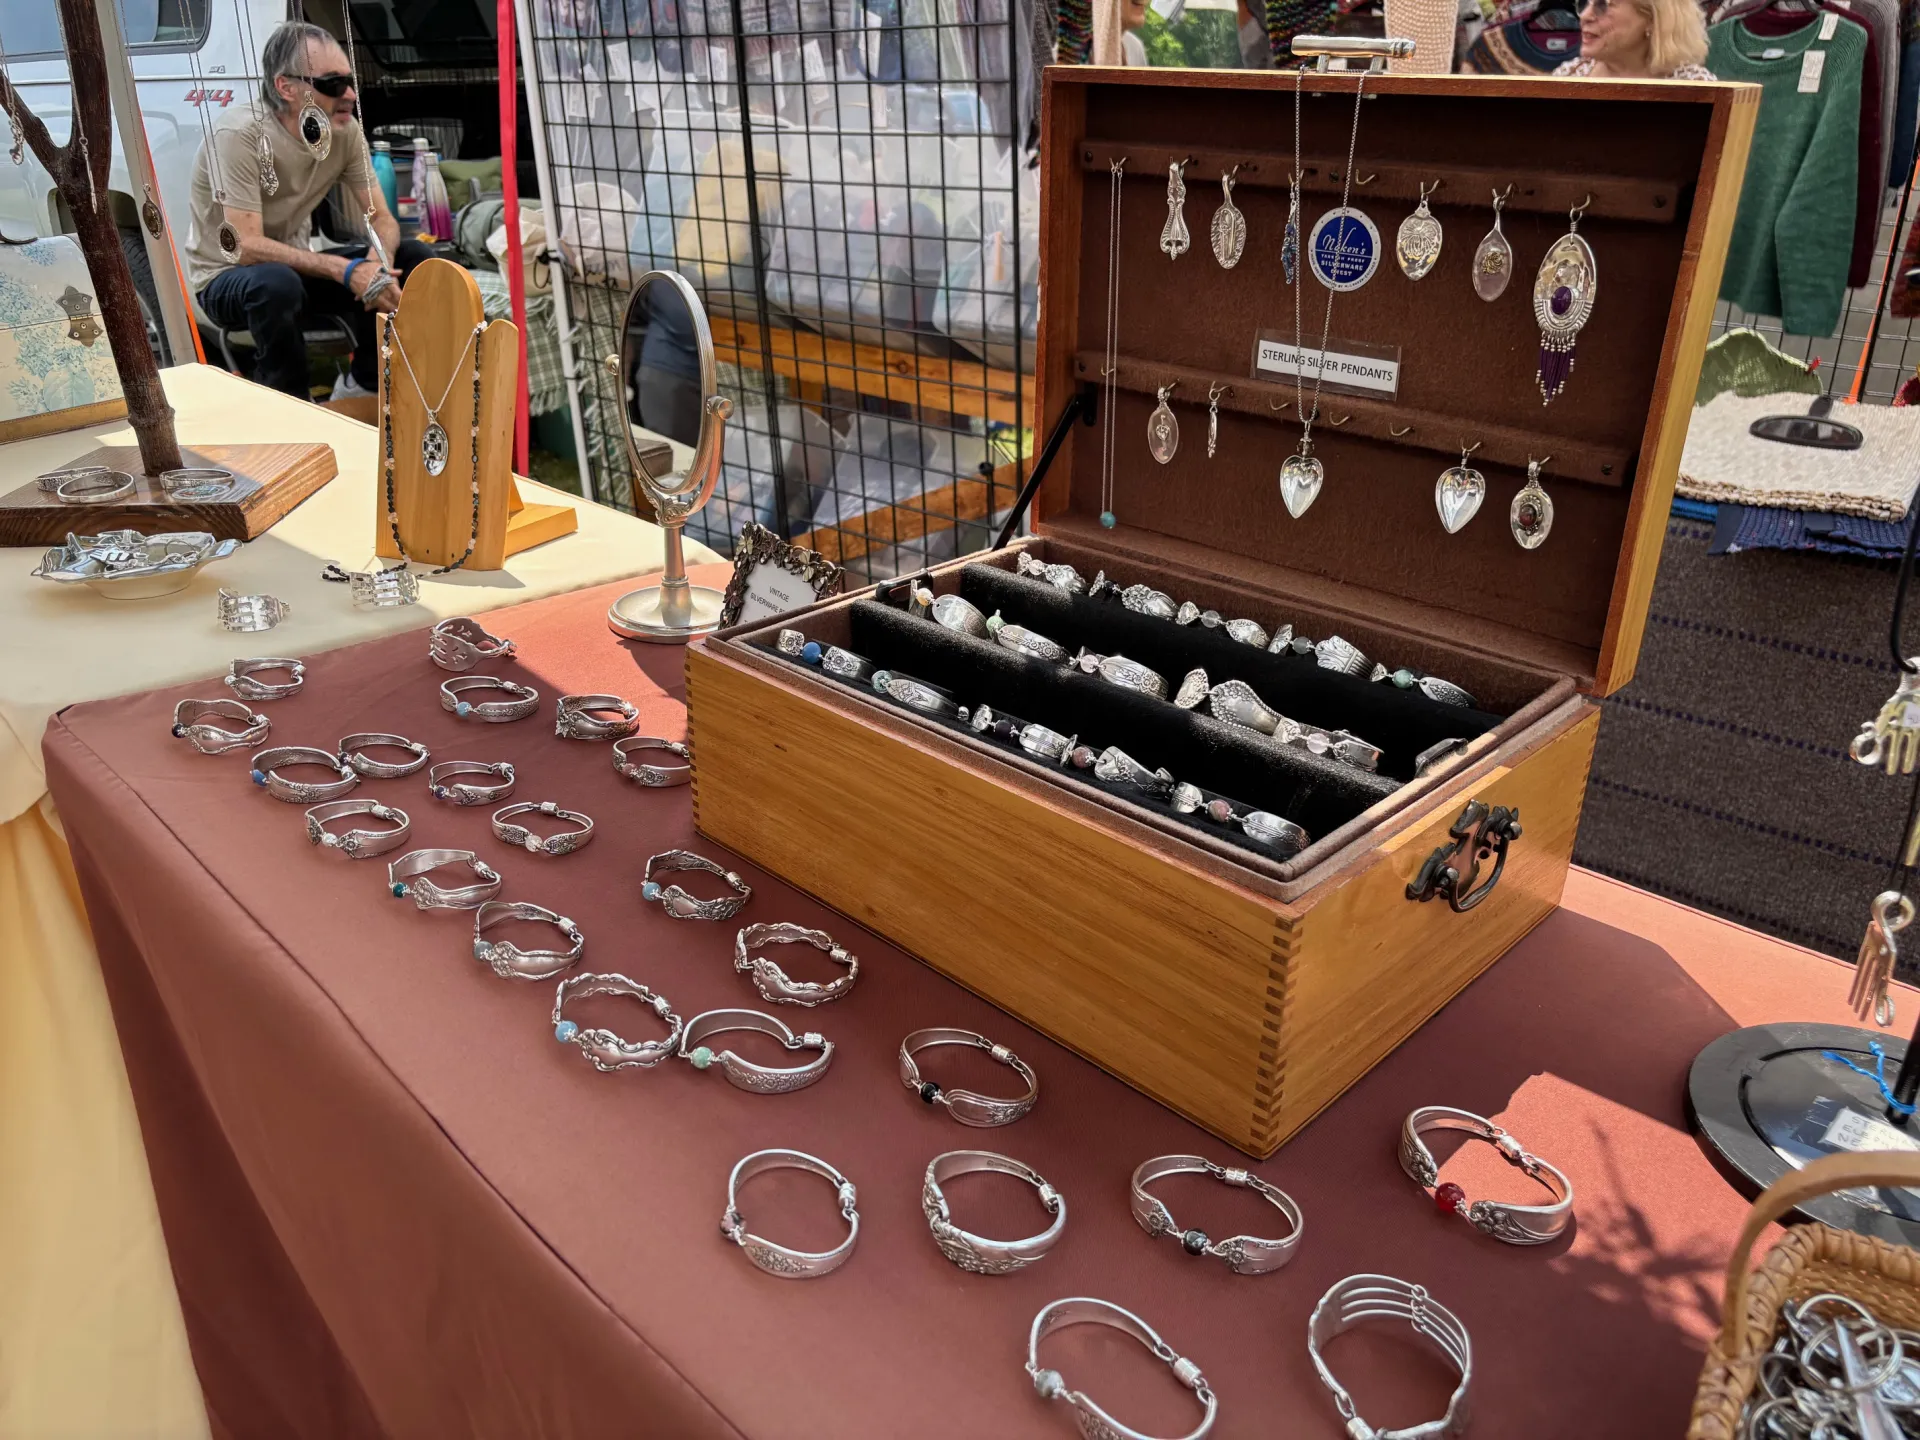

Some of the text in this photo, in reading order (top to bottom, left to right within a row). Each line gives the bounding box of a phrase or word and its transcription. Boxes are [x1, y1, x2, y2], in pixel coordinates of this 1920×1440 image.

[1262, 349, 1393, 382] STERLING SILVER PENDANTS
[750, 592, 779, 614] SILVERWARE
[769, 586, 790, 603] VINTAGE
